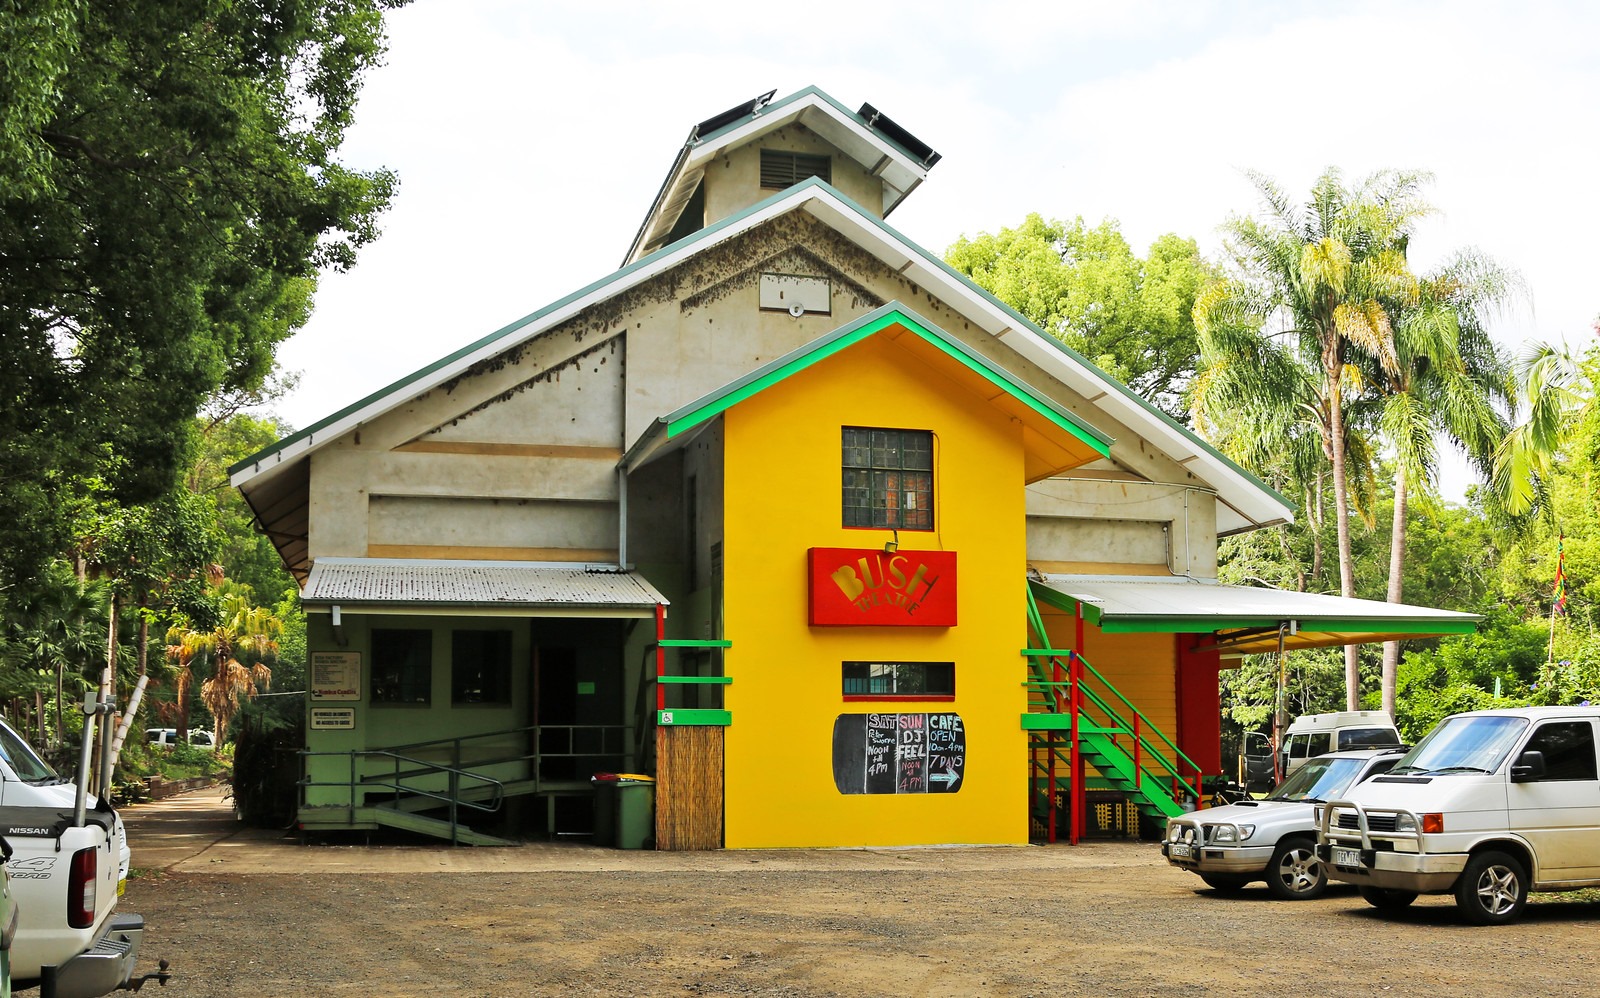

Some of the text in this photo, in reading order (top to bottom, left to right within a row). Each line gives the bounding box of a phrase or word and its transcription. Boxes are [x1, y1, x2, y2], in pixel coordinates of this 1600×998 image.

[830, 554, 939, 603] BUSH
[853, 591, 921, 617] THEATRE
[869, 714, 897, 729] SAT
[899, 715, 923, 729] SUN
[929, 715, 963, 732] CAFE
[903, 730, 924, 744] DJ
[930, 730, 956, 742] OPEN
[896, 744, 927, 759] FEEL
[901, 761, 921, 771] NOON
[929, 754, 963, 770] 7 DAYS
[9, 827, 49, 835] NISSAN
